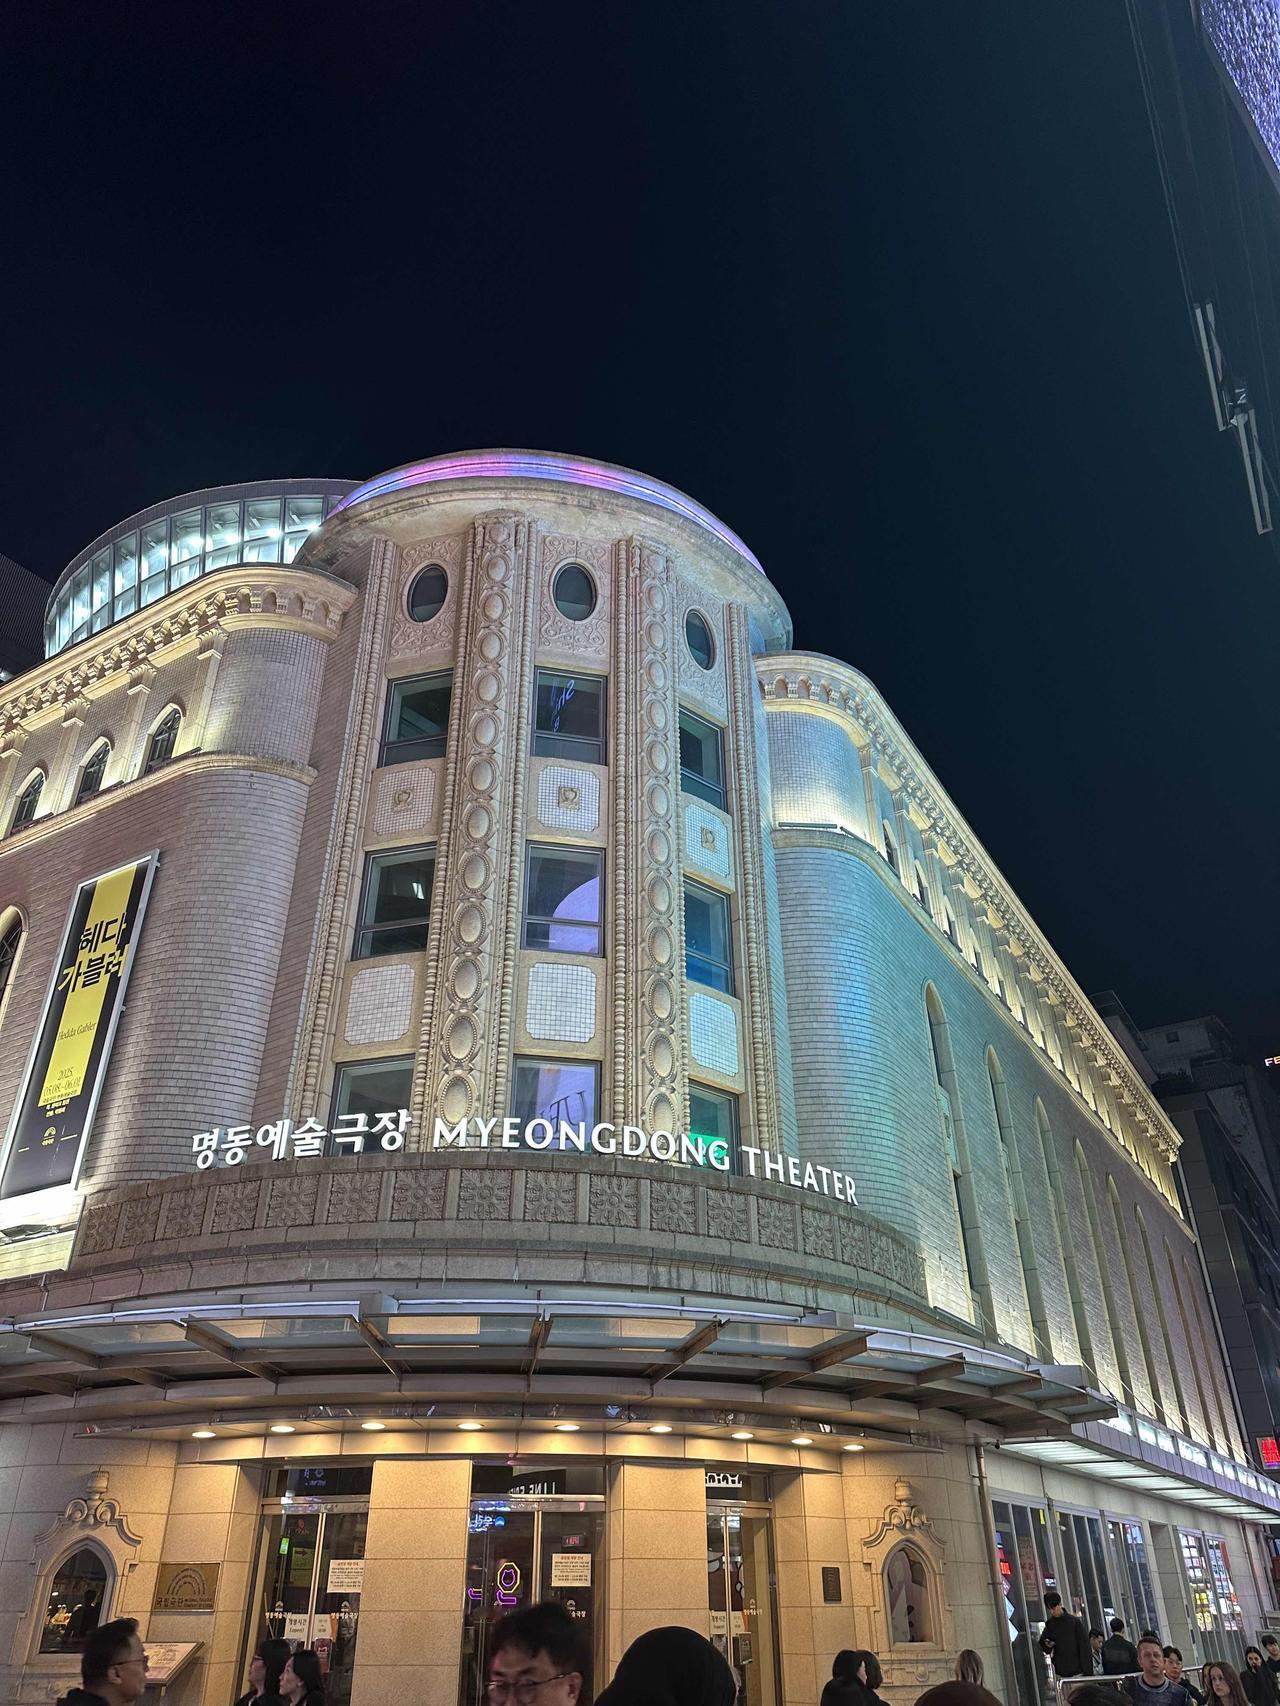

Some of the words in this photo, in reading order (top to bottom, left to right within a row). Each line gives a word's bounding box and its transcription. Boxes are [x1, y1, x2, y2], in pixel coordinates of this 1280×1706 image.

[80, 912, 127, 954] 헤다
[57, 944, 129, 993] 가블러
[76, 1022, 98, 1036] Gabler
[192, 1108, 412, 1170] 명동예술극장
[433, 1116, 729, 1172] MYEONGDONG
[739, 1144, 860, 1207] THEATER
